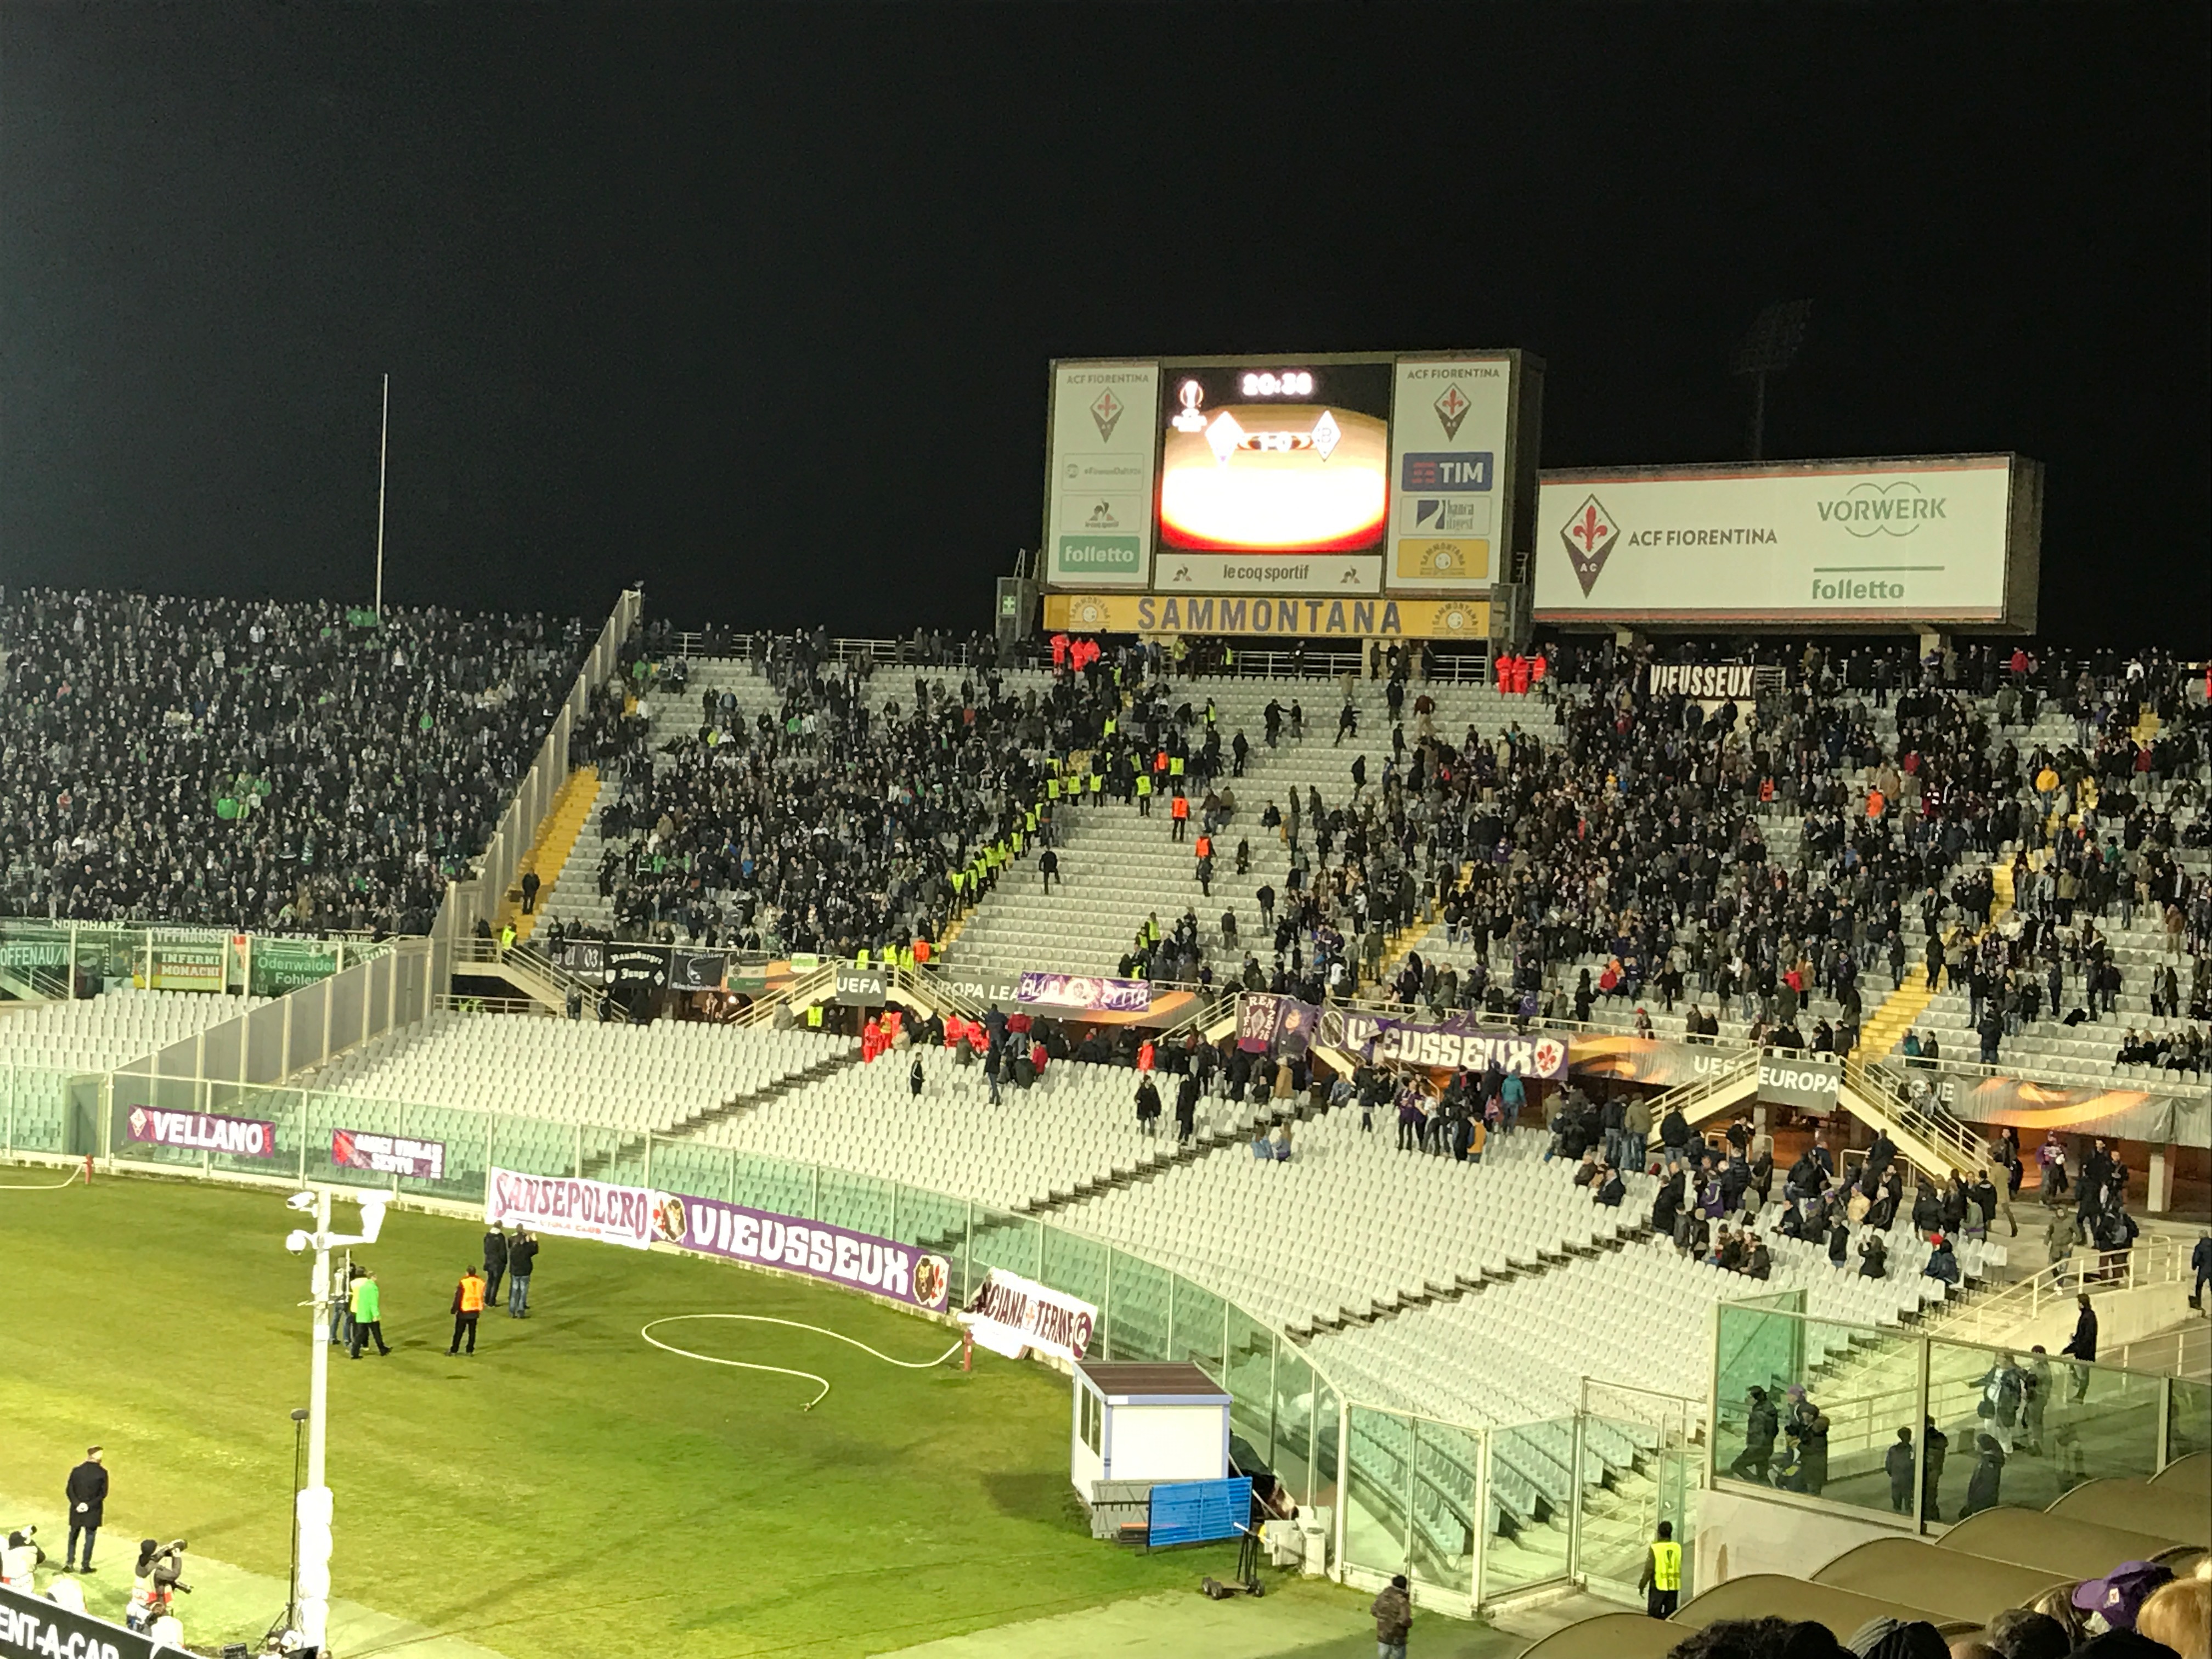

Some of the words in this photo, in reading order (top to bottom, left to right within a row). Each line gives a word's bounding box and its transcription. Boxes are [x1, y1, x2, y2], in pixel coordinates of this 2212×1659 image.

[1066, 375, 1086, 384] ACF
[1088, 374, 1149, 383] FIORENTINA
[1407, 369, 1429, 379] ACF
[1431, 368, 1500, 379] FIORENTINA
[1439, 462, 1484, 483] TIM
[1817, 498, 1946, 521] VORWERK
[1628, 530, 1662, 547] ACF
[1667, 528, 1778, 546] FIORENTINA
[1065, 545, 1134, 562] folletto
[1813, 579, 1905, 600] folletto
[1138, 596, 1402, 634] SAMMONTANA
[53, 919, 125, 930] NORDHARZ
[162, 953, 219, 965] INFERNI
[161, 966, 219, 977] MONACHI
[836, 977, 882, 994] UEFA
[1347, 1018, 1532, 1075] VEUSSEUX
[1758, 1066, 1838, 1093] EUROPA
[153, 1110, 263, 1154] VELLANO
[494, 1172, 648, 1240] SANSEPOLCRO
[692, 1204, 909, 1295] VIEUSSEUX
[1033, 1300, 1074, 1348] TERME
